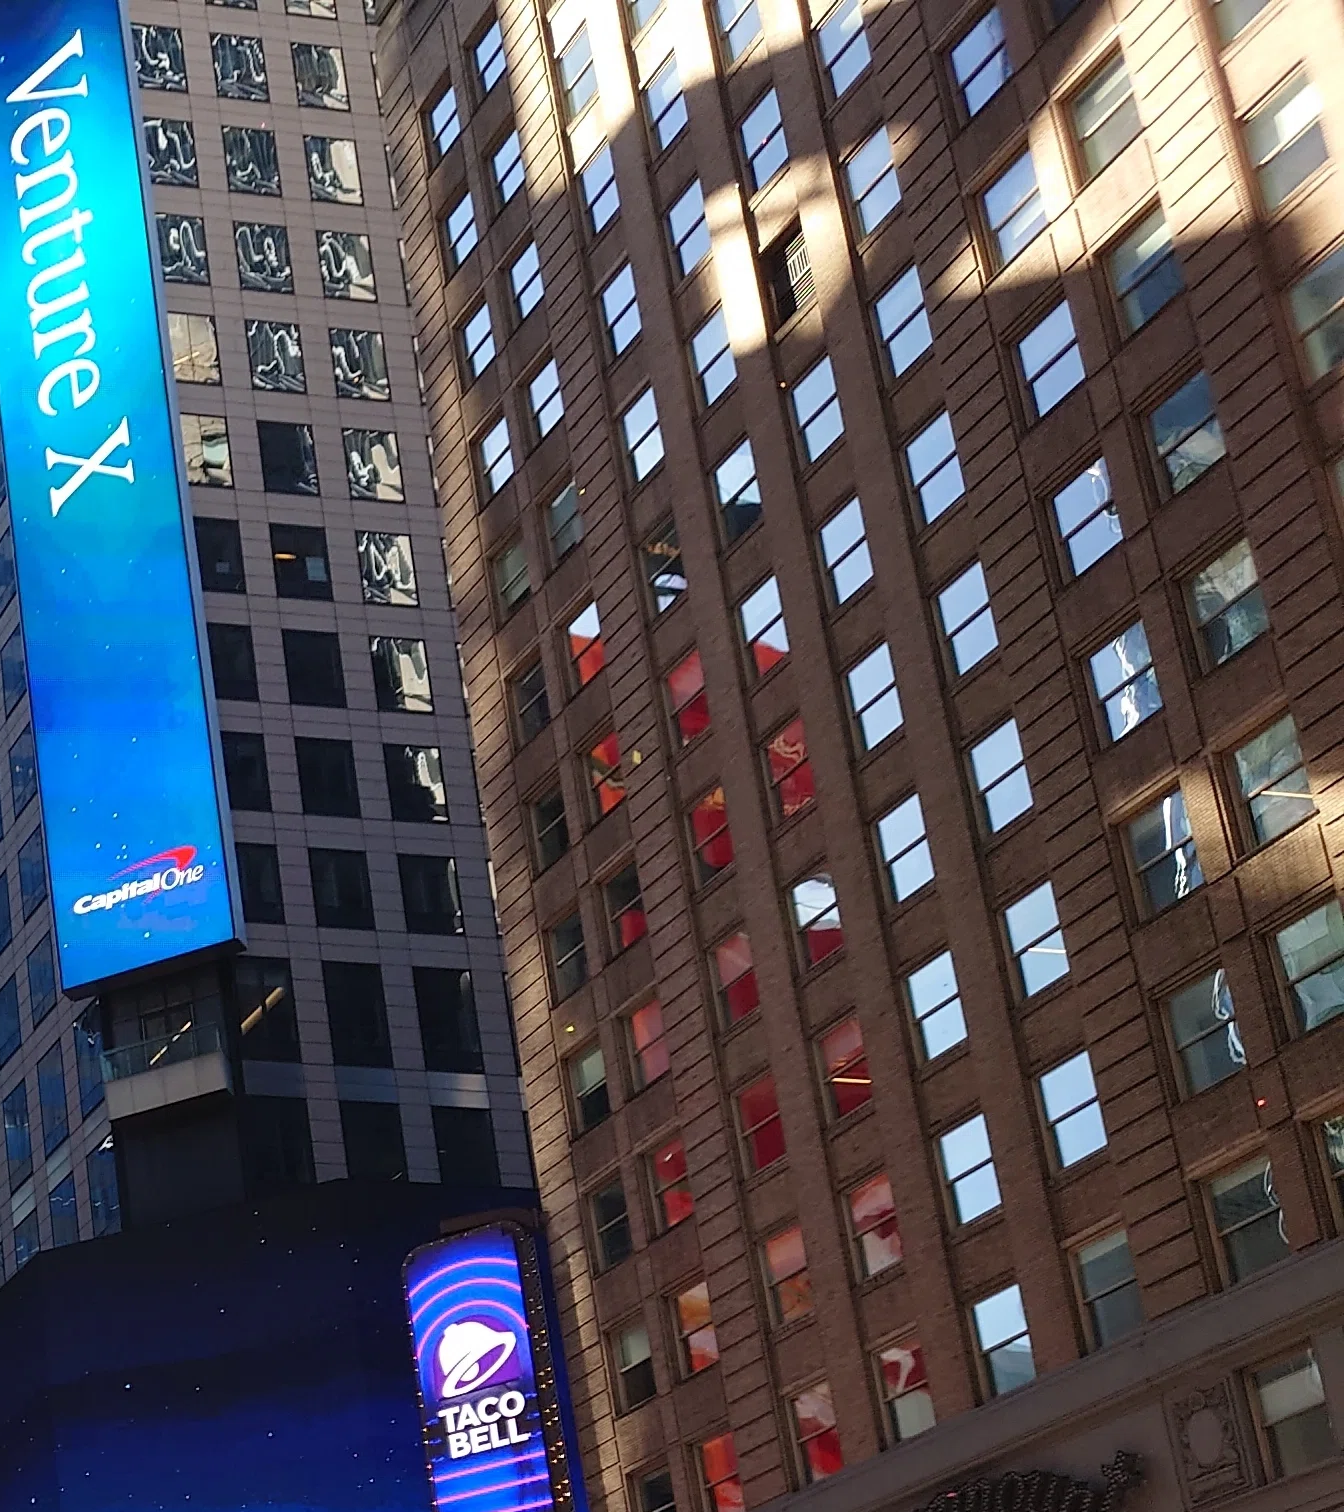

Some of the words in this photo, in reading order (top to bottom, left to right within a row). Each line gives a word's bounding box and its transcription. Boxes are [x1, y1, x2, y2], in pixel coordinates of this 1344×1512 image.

[6, 29, 102, 417] Venture
[46, 416, 135, 518] X
[438, 1390, 526, 1434] TACO
[448, 1418, 532, 1460] BELL
